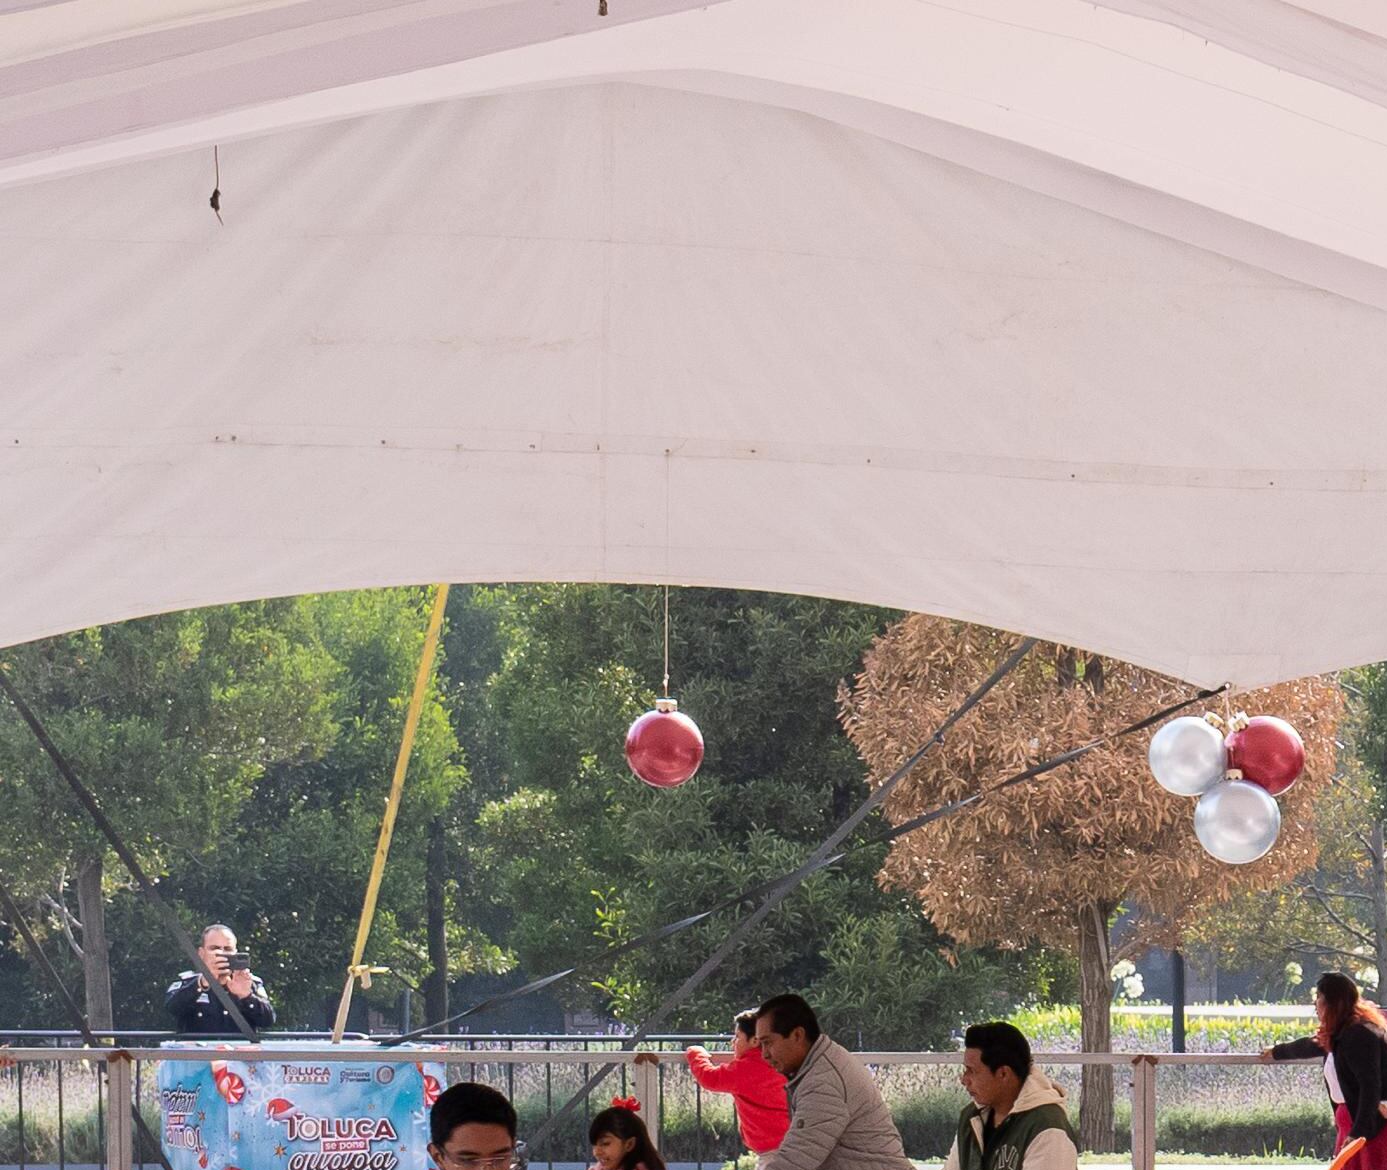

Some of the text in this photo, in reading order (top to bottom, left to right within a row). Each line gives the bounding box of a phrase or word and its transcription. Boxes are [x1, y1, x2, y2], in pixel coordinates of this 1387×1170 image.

[281, 1064, 331, 1076] TOLUCA
[284, 1113, 397, 1140] TOLUCA
[324, 1141, 366, 1152] se pone
